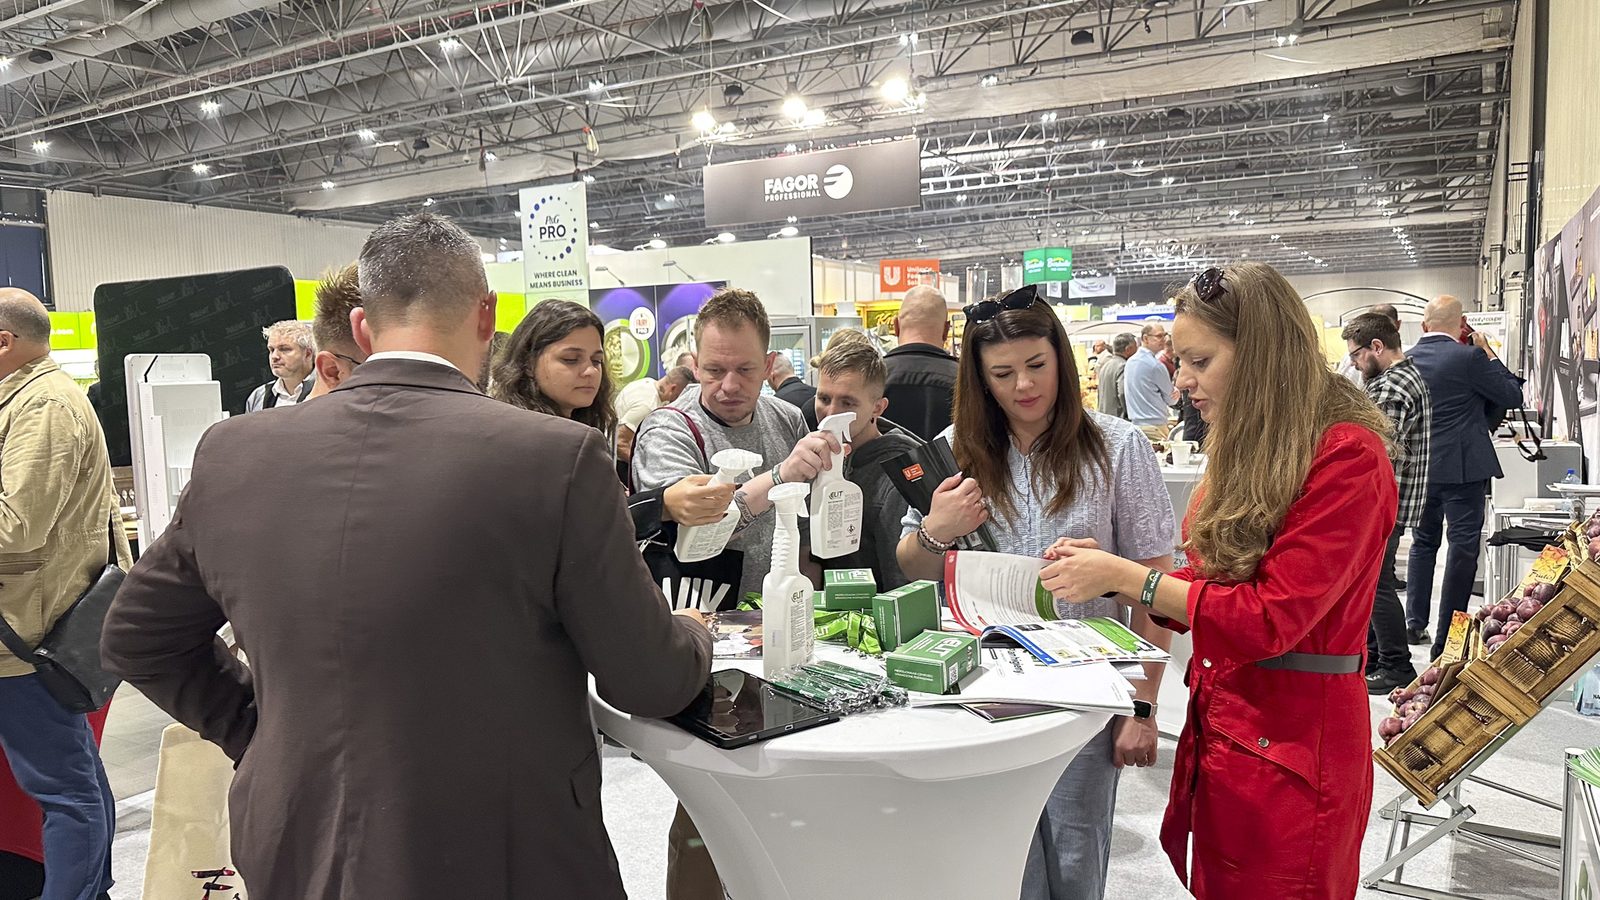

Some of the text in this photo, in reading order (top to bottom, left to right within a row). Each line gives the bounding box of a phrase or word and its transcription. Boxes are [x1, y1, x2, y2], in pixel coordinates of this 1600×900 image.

[764, 174, 819, 194] FAGOR
[764, 190, 821, 202] PROFESSIONAL
[539, 224, 567, 239] PRO
[534, 269, 578, 279] WHERE CLEAN
[529, 279, 583, 289] MEANS BUSINESS
